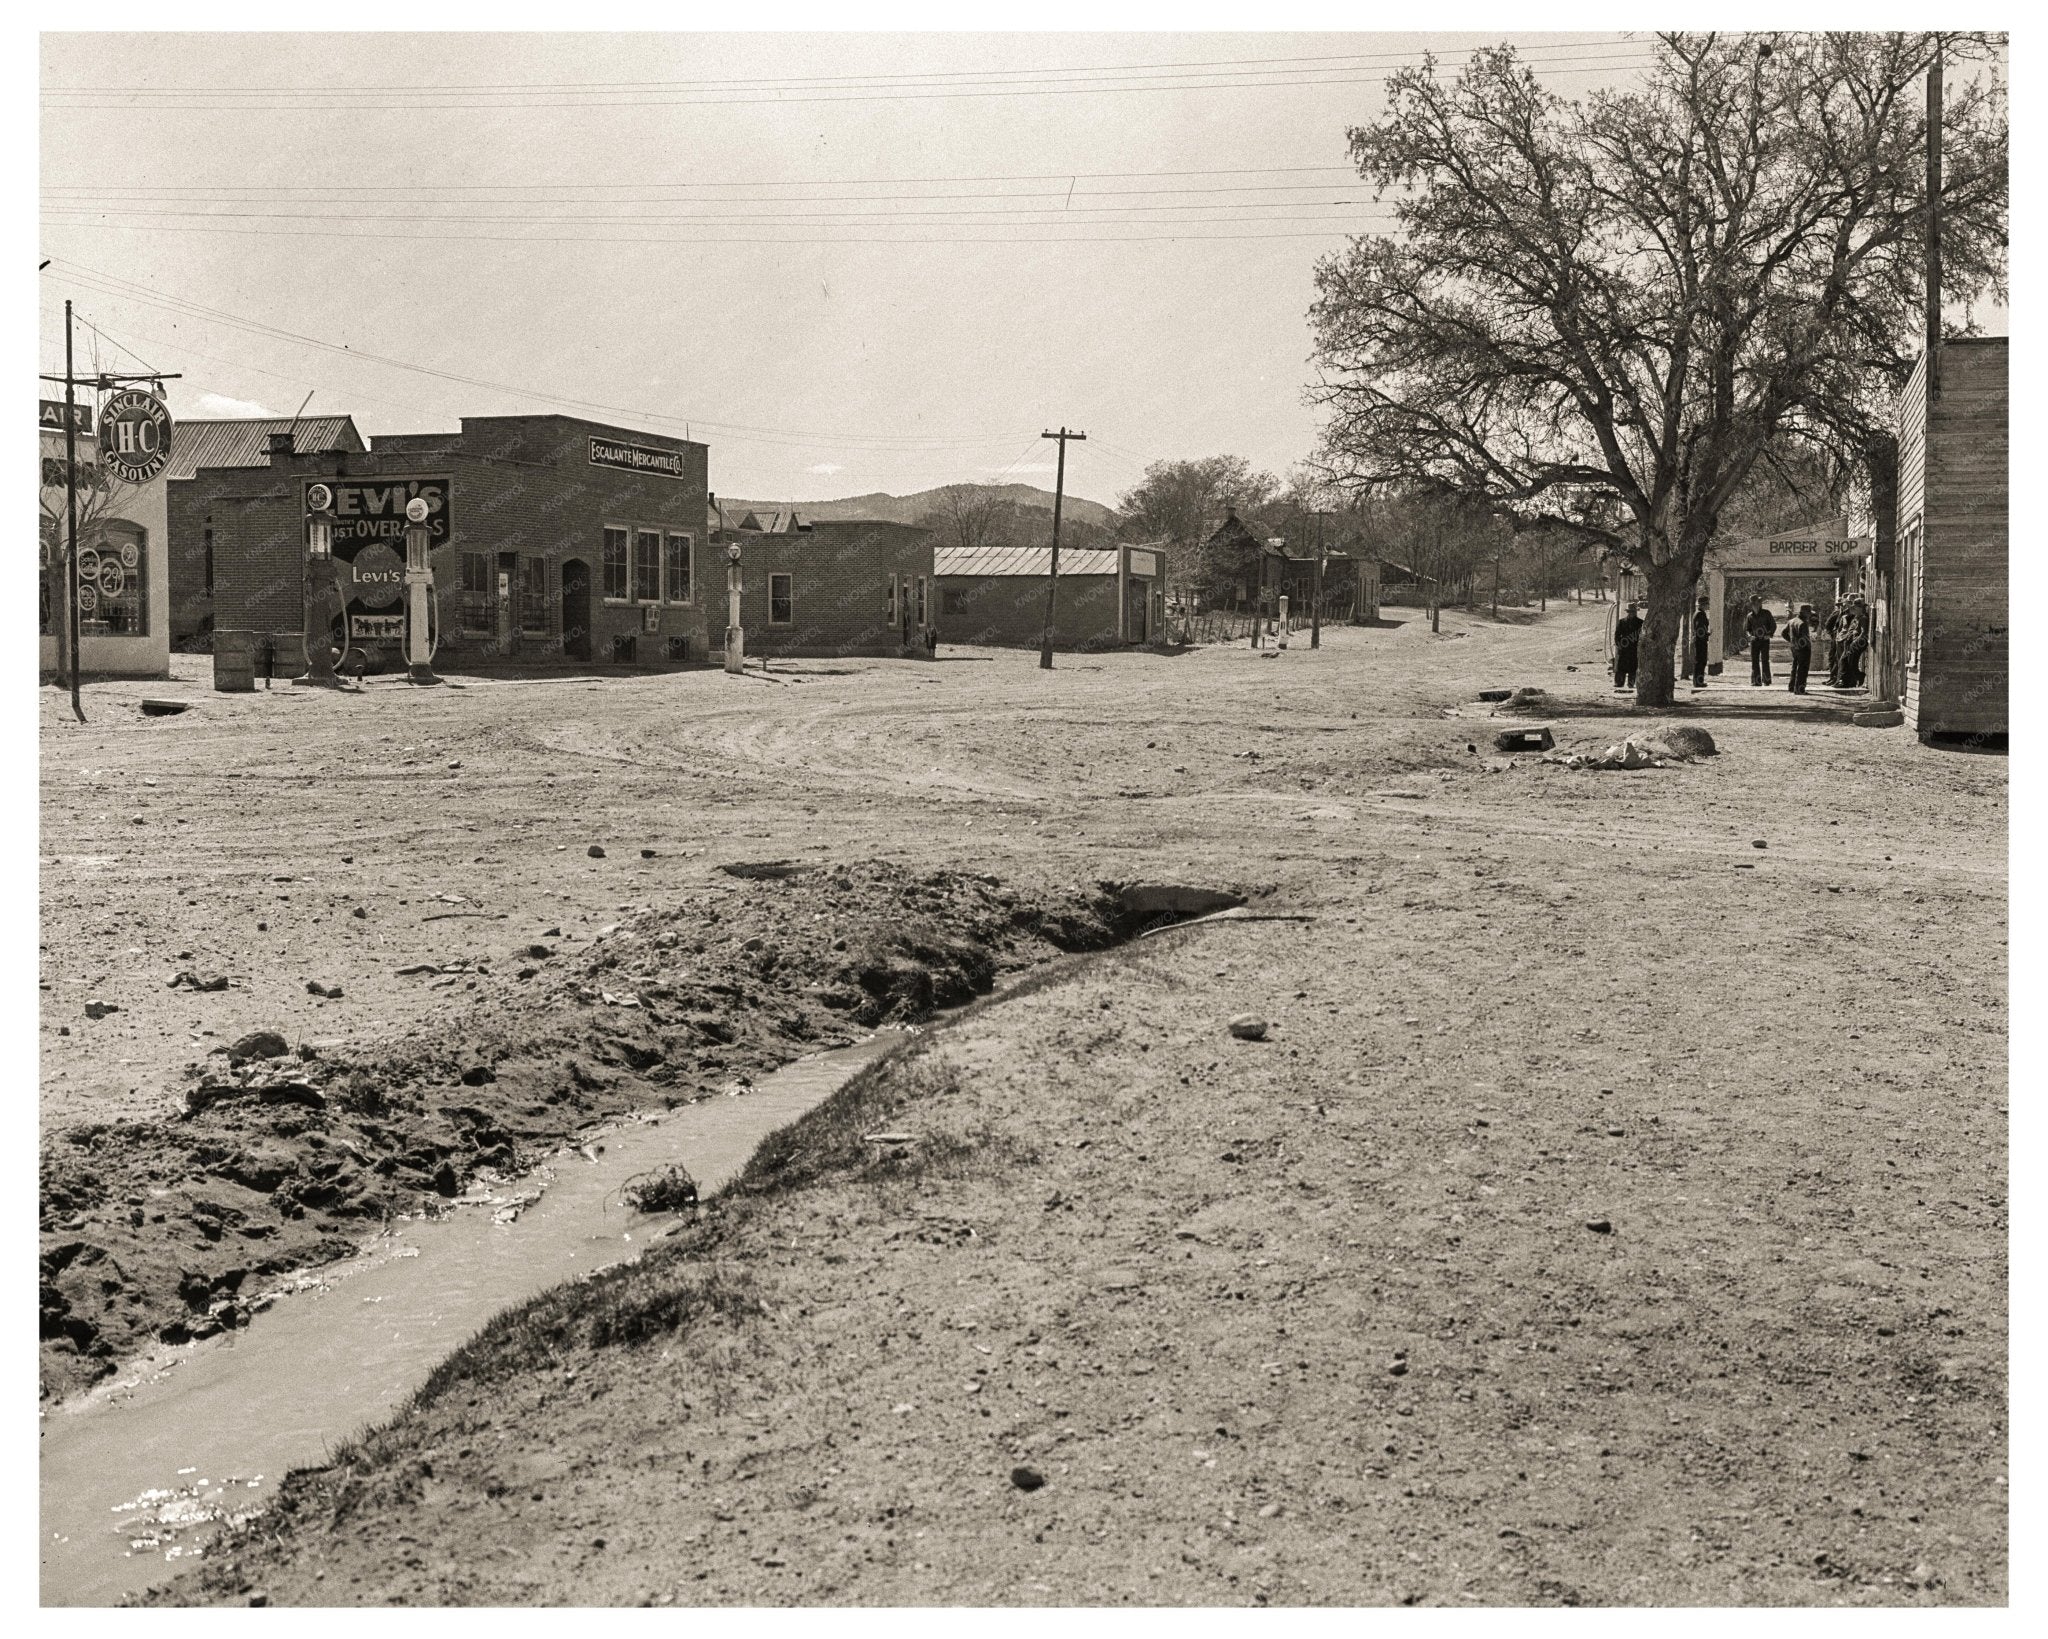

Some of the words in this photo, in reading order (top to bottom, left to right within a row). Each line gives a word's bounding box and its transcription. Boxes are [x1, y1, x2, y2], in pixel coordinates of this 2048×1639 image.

[39, 406, 83, 426] AIR
[103, 394, 166, 427] SINCLAIR
[104, 449, 168, 482] GASOLINE
[591, 441, 632, 464] ESCALANTE
[632, 449, 673, 470] MERCANTILE
[328, 481, 443, 515] EVI'S
[356, 519, 444, 538] OVERS
[1769, 541, 1818, 554] BARBER
[1825, 540, 1859, 554] SHOP
[352, 566, 401, 583] Levi's
